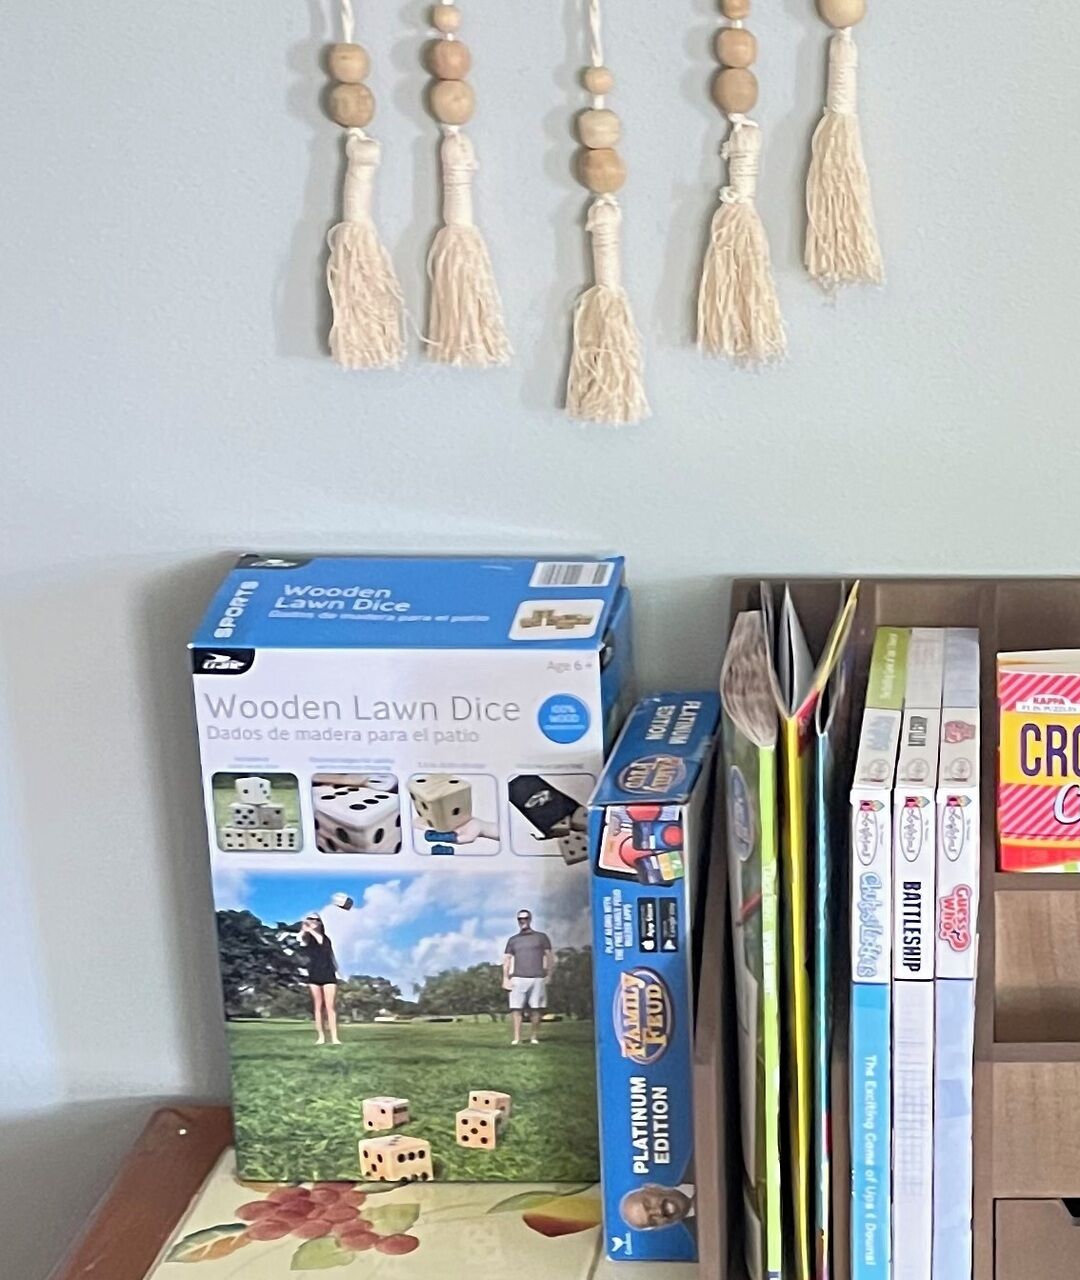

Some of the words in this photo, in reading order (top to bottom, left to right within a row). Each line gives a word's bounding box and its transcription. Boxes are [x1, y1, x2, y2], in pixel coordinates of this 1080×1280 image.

[274, 597, 345, 610] Lawn
[352, 598, 411, 612] Dice
[283, 584, 391, 599] Wooden
[213, 580, 260, 639] SPORTS
[546, 661, 572, 674] Age
[204, 693, 342, 721] Wooden
[354, 694, 438, 721] Lawn
[451, 696, 521, 722] Dice
[645, 705, 677, 740] EDITION
[668, 701, 703, 745] PLATINUM
[207, 725, 263, 741] Dados
[268, 726, 290, 741] de
[296, 727, 362, 742] madera
[368, 730, 409, 747] para
[412, 728, 428, 742] el
[434, 729, 480, 745] patio
[902, 881, 922, 972] BATTLESHIP
[621, 972, 646, 1058] FAMILY
[643, 983, 668, 1046] FEUD
[865, 1055, 878, 1077] The
[862, 1079, 878, 1130] Exciting
[629, 1076, 650, 1175] PLATINUM
[651, 1086, 671, 1165] EDITION
[864, 1132, 877, 1166] Game
[864, 1169, 879, 1184] of
[862, 1185, 878, 1213] Ups
